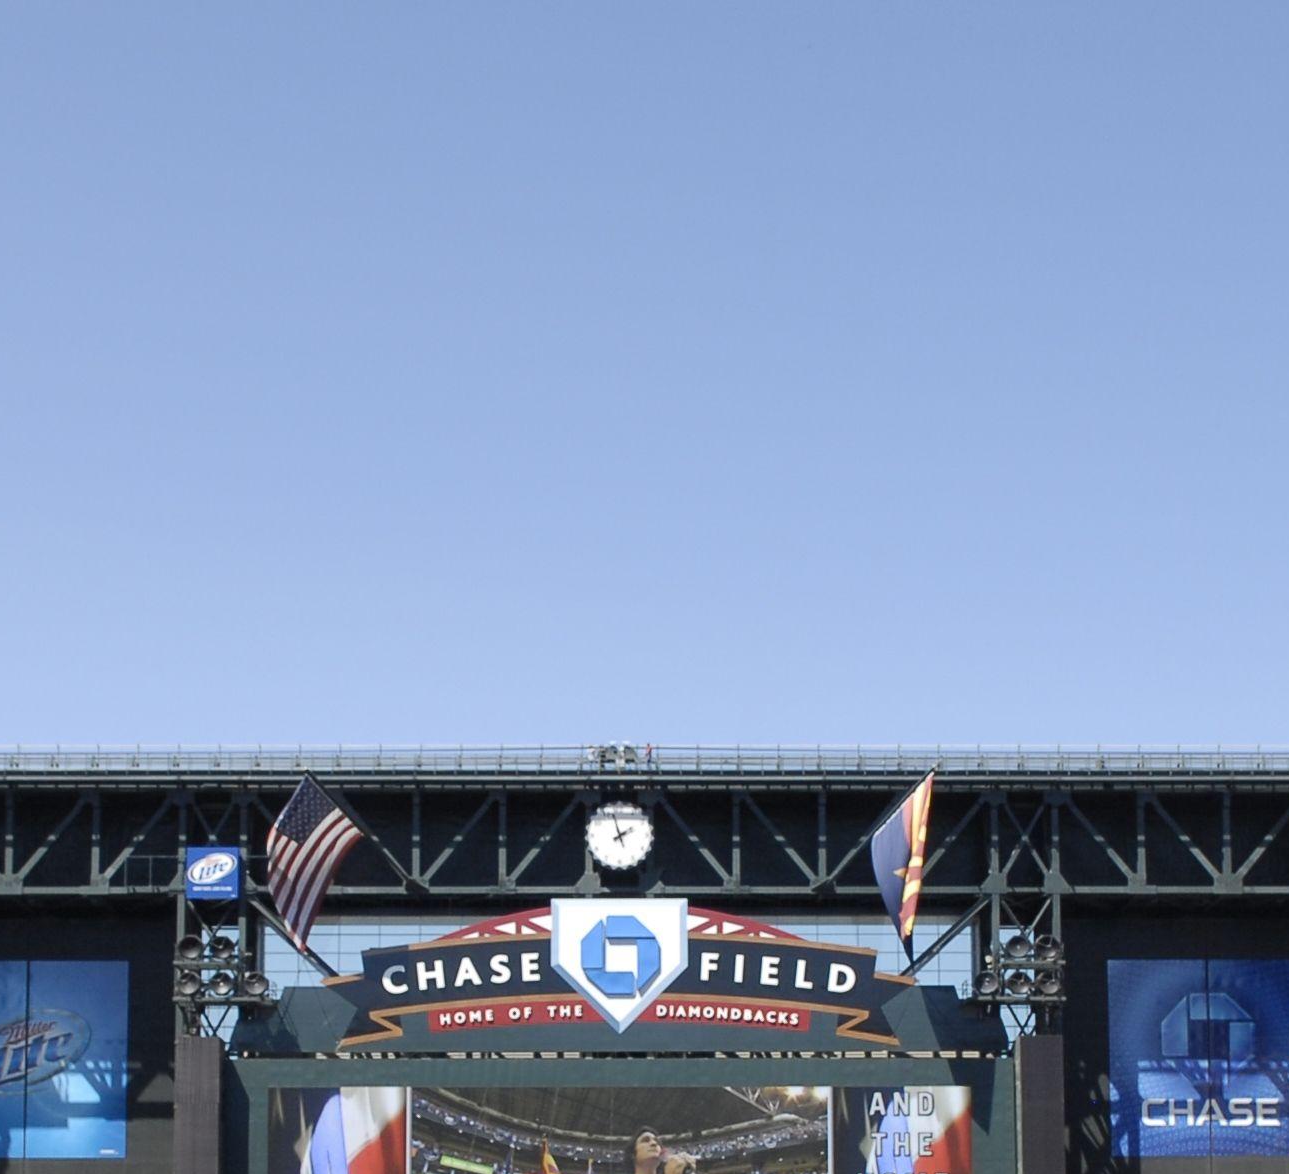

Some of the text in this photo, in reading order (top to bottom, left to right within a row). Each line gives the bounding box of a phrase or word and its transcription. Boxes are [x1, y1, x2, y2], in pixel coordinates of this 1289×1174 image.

[382, 953, 541, 995] CHASE
[699, 952, 858, 994] FIELD
[439, 1004, 584, 1026] HOME OF THE
[655, 1004, 800, 1026] DIAMONDBACKS
[1, 1020, 57, 1044] Miller
[869, 1092, 935, 1117] AND
[1141, 1097, 1282, 1127] CHASE
[872, 1132, 934, 1157] THE
